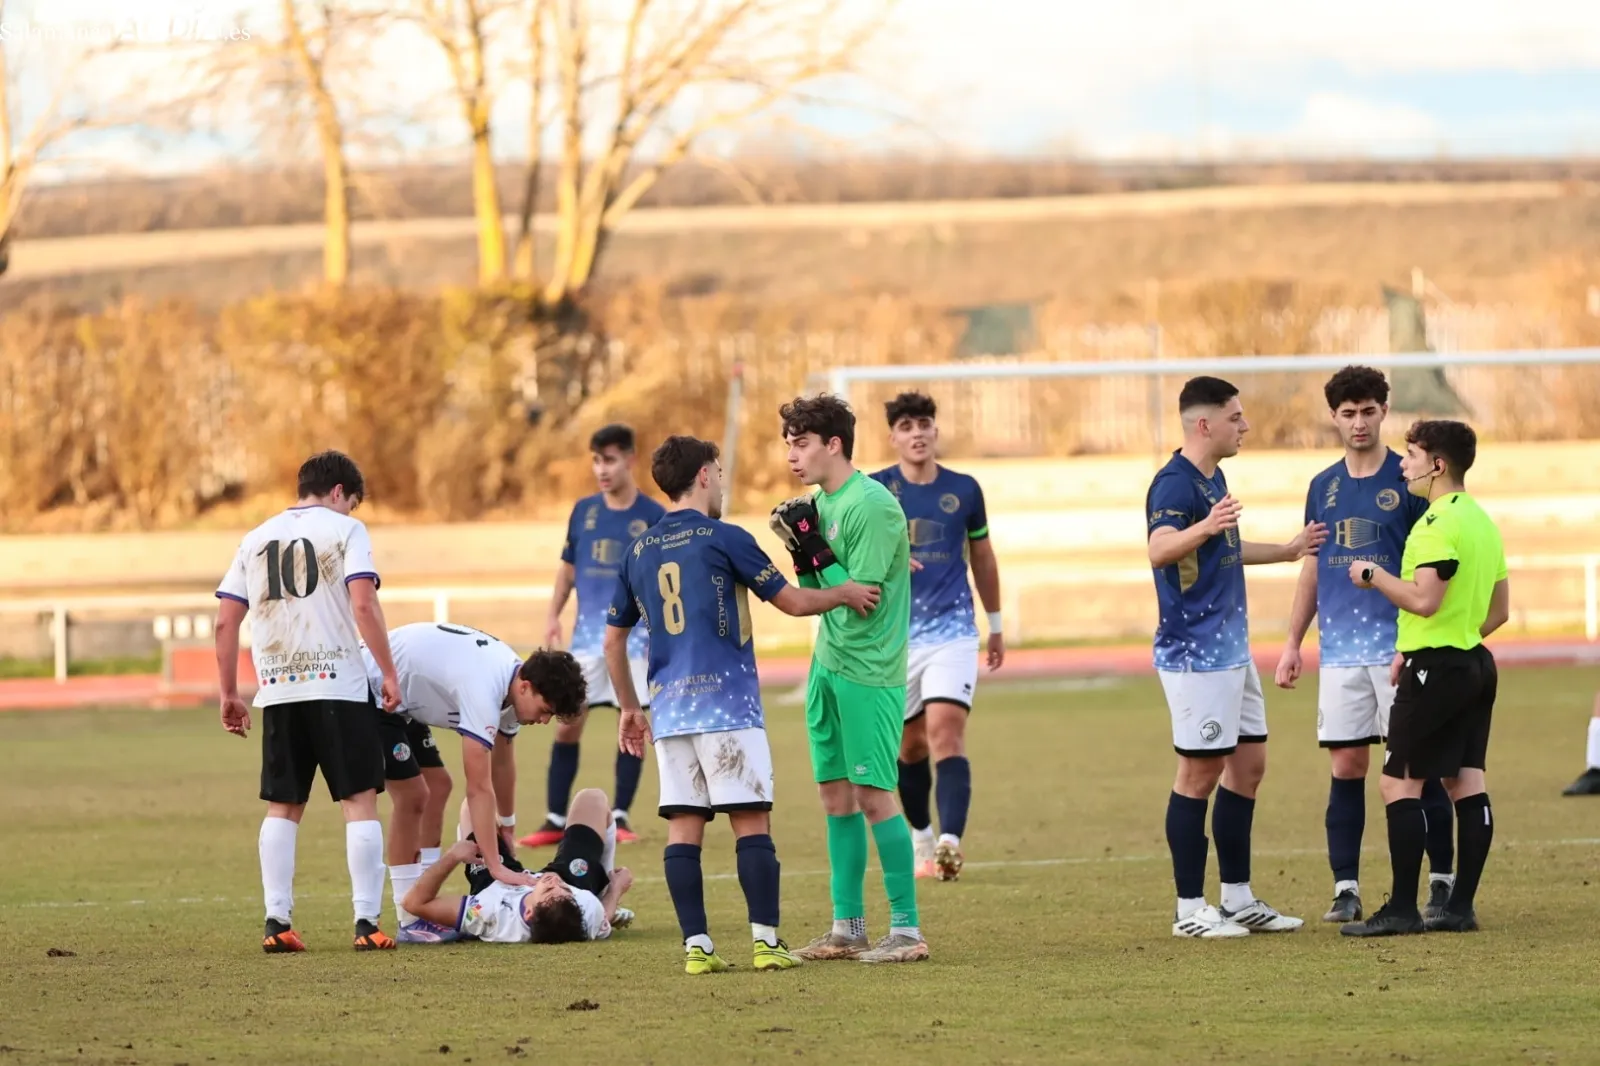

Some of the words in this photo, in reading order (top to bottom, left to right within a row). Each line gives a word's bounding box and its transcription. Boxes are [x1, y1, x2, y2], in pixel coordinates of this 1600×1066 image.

[646, 536, 660, 546] De
[662, 529, 693, 543] Castro
[696, 527, 713, 536] Gil
[257, 537, 319, 601] 10
[1328, 555, 1366, 564] HIERROS
[658, 561, 685, 635] 8
[711, 574, 726, 637] GUINALDO
[261, 663, 337, 678] EMPRESARIAL
